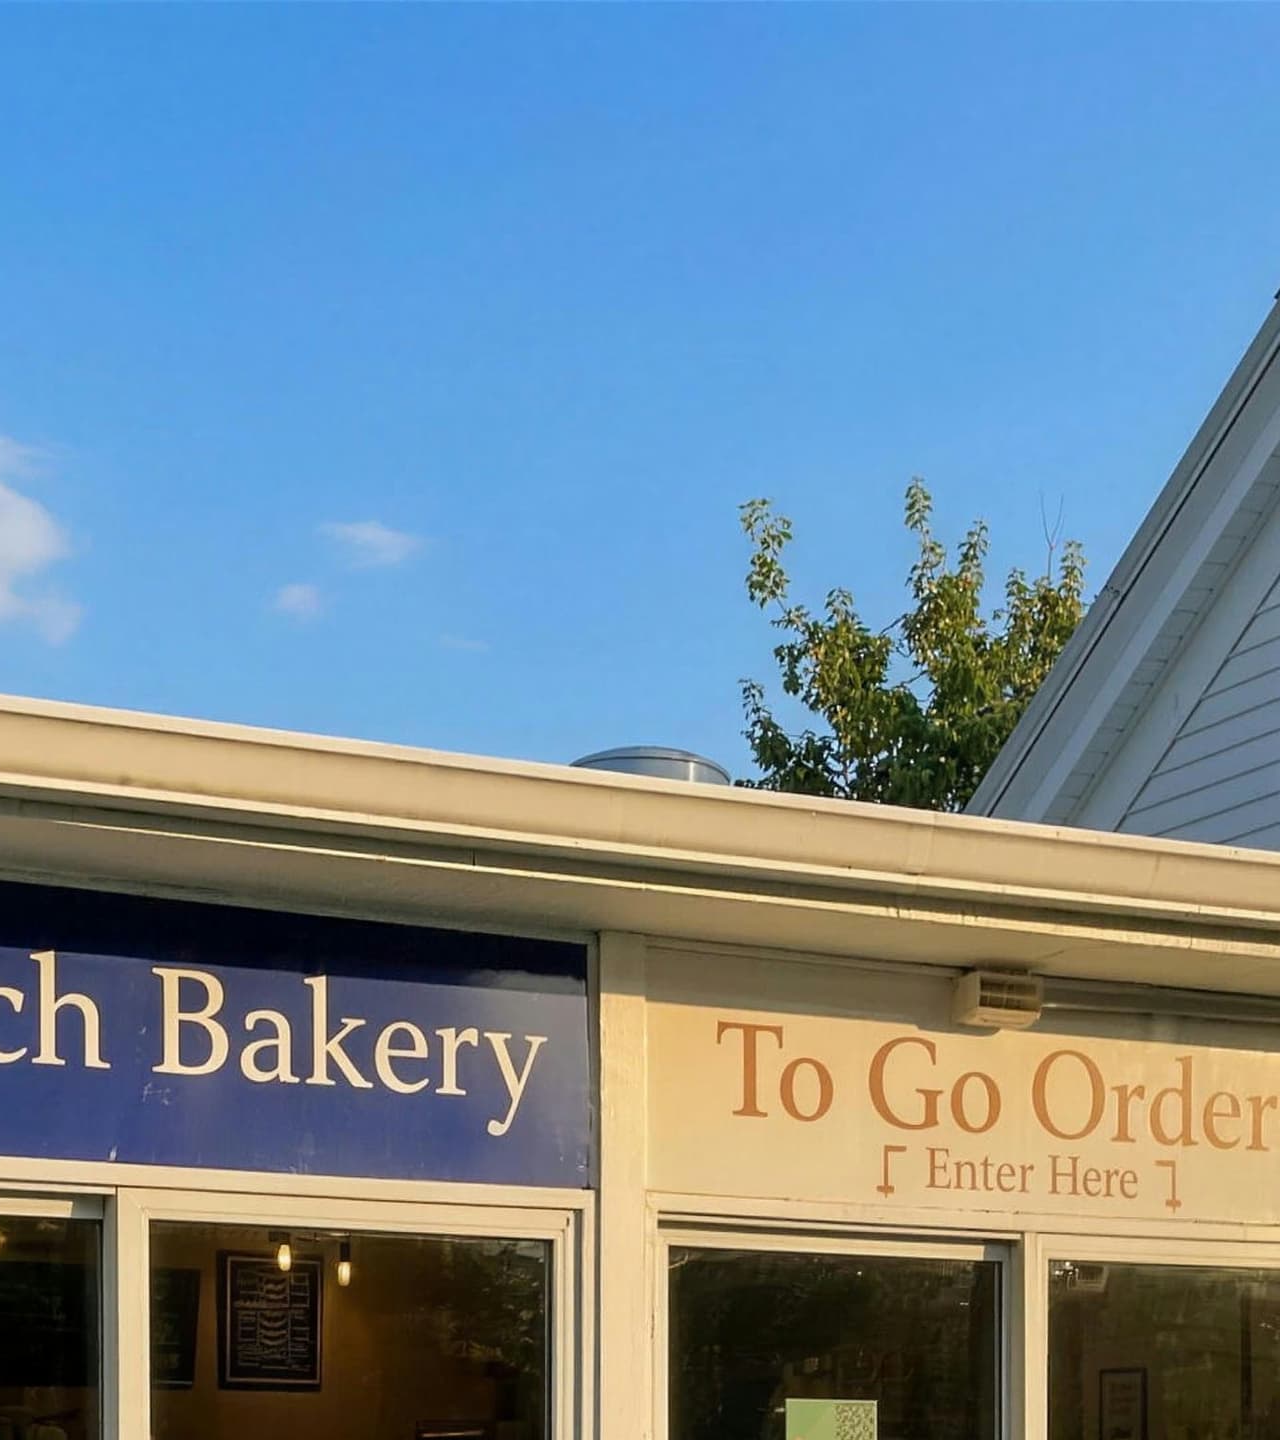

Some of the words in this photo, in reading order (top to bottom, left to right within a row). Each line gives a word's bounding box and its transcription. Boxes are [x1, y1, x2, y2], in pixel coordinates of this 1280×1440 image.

[151, 966, 547, 1137] Bakery
[716, 1020, 834, 1121] To
[868, 1036, 1002, 1133] Go
[925, 1147, 1034, 1194] Enter
[1048, 1156, 1140, 1199] Here
